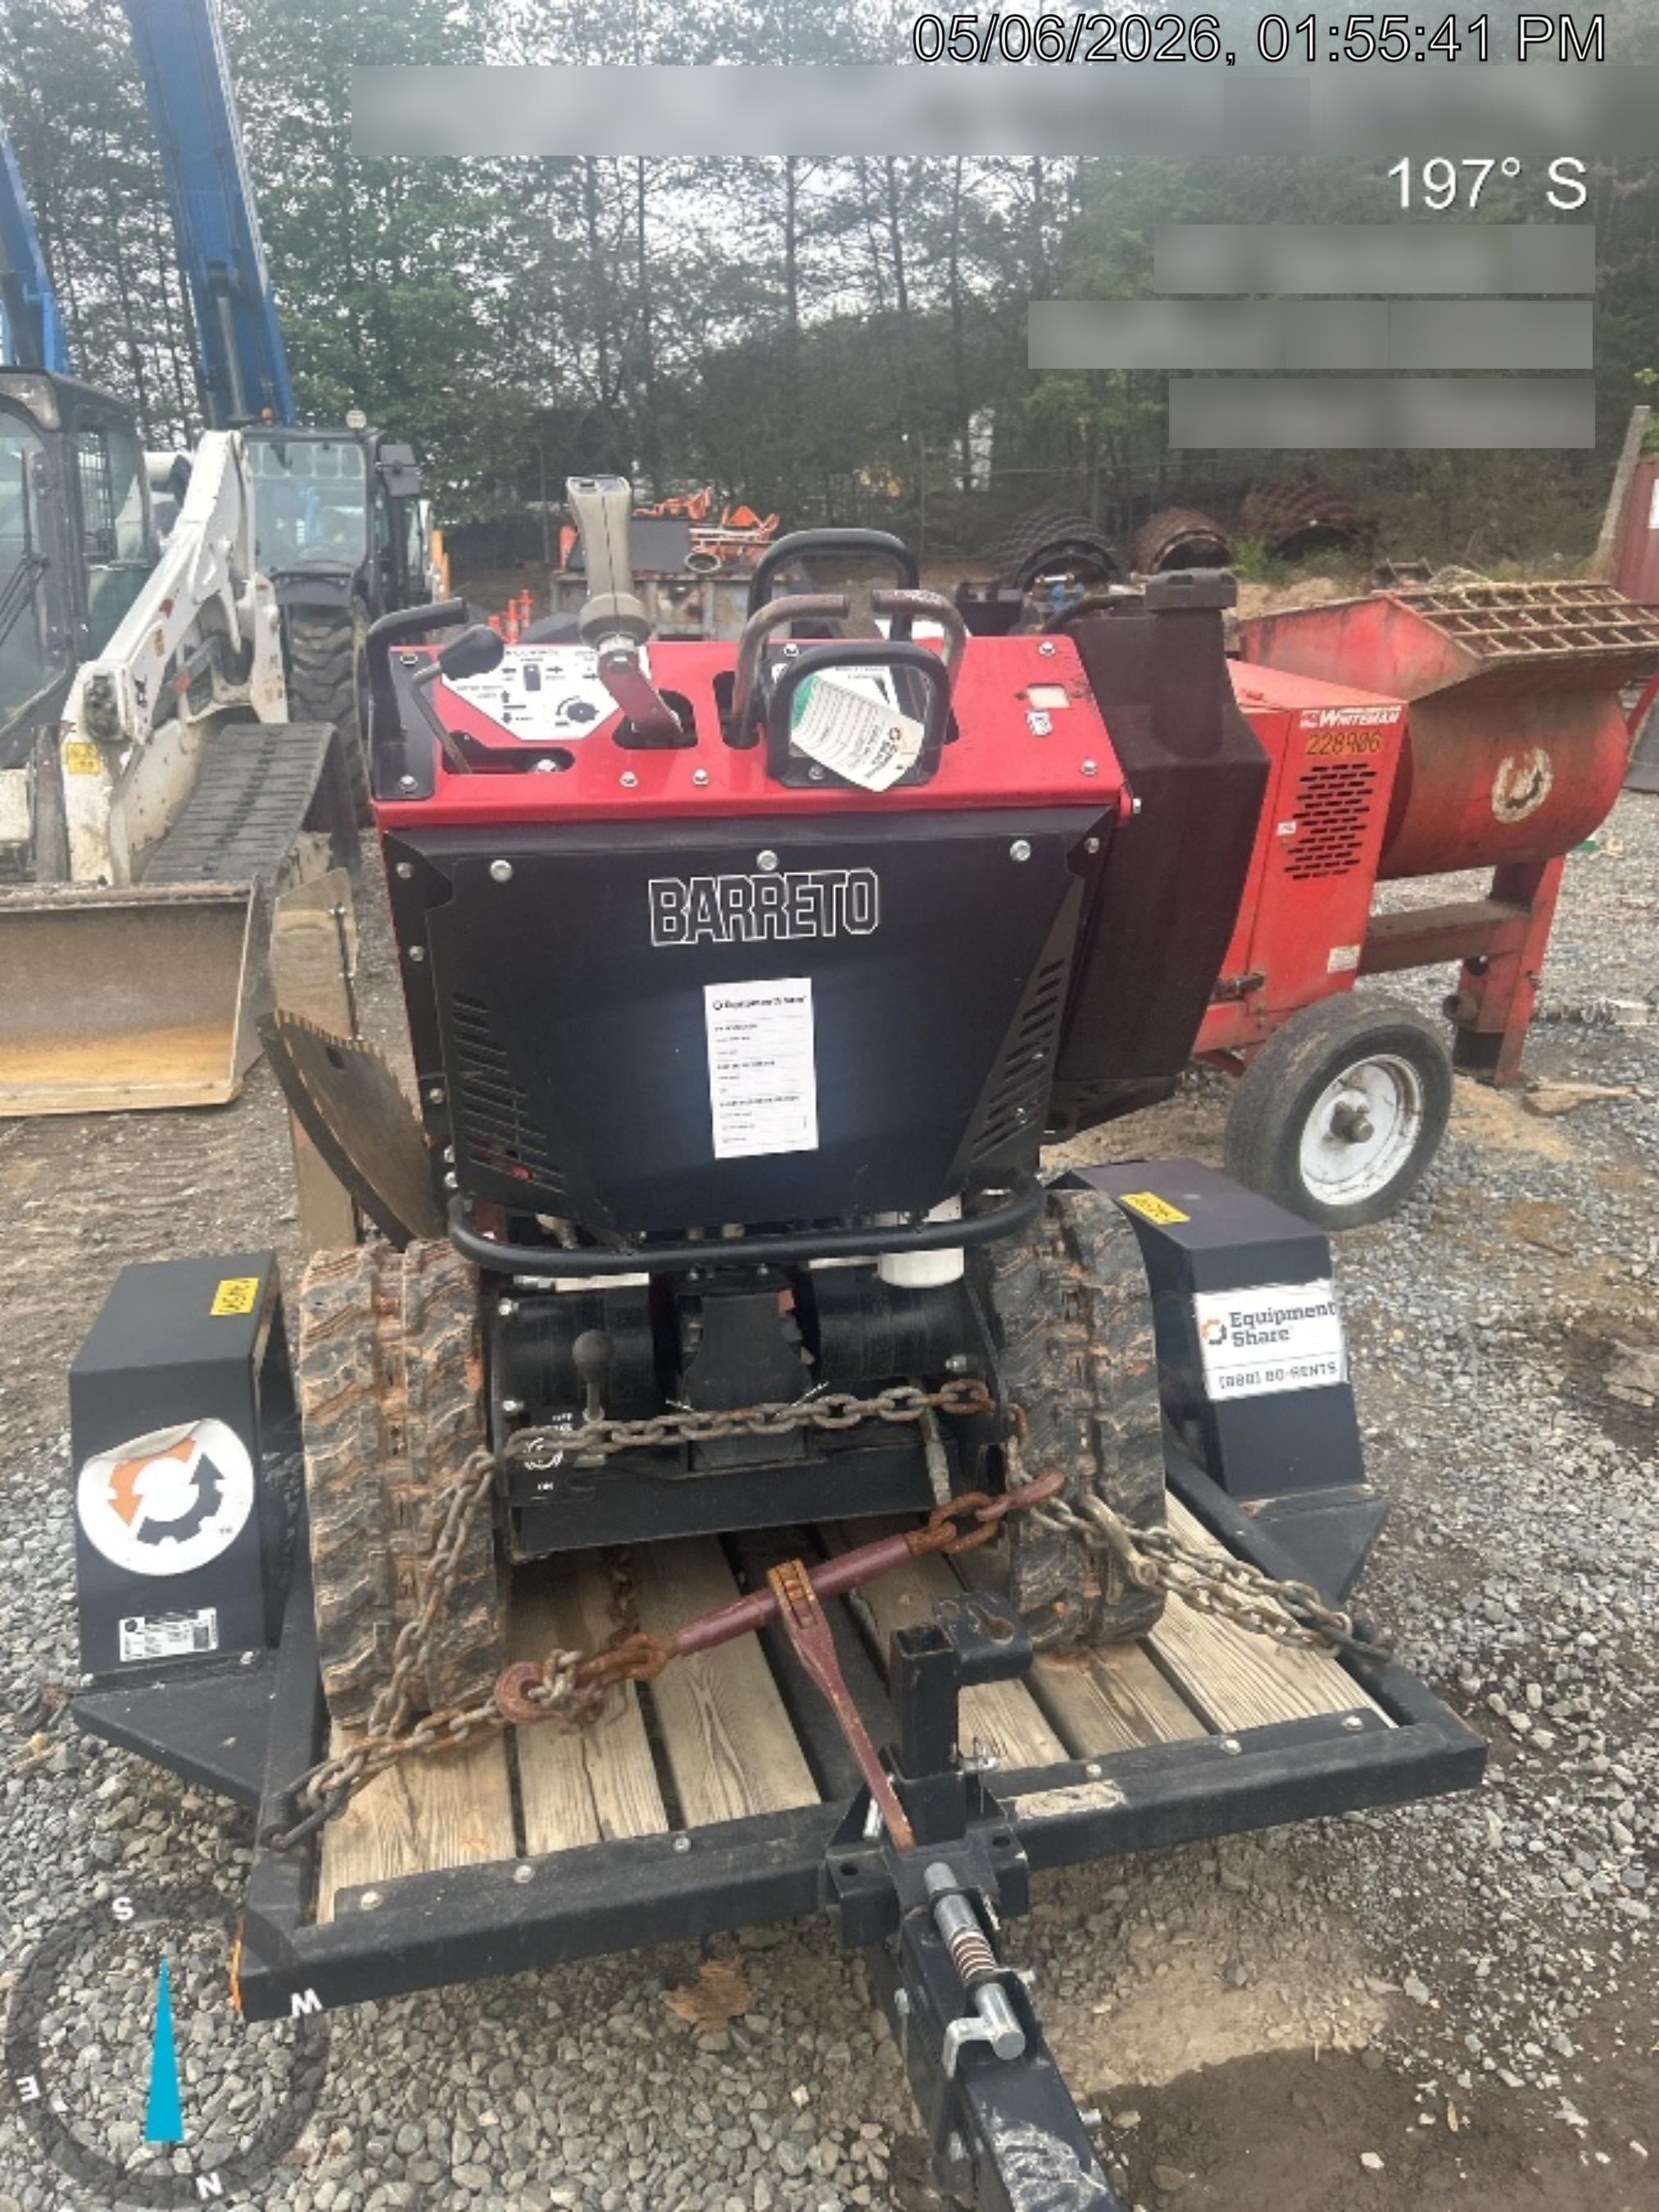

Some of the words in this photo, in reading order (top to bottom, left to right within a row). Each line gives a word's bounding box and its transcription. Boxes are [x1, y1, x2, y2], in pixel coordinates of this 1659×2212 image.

[1306, 730, 1381, 755] 228906
[648, 868, 878, 946] BARRETO
[1229, 1301, 1337, 1329] Equipment
[1231, 1329, 1290, 1348] Share
